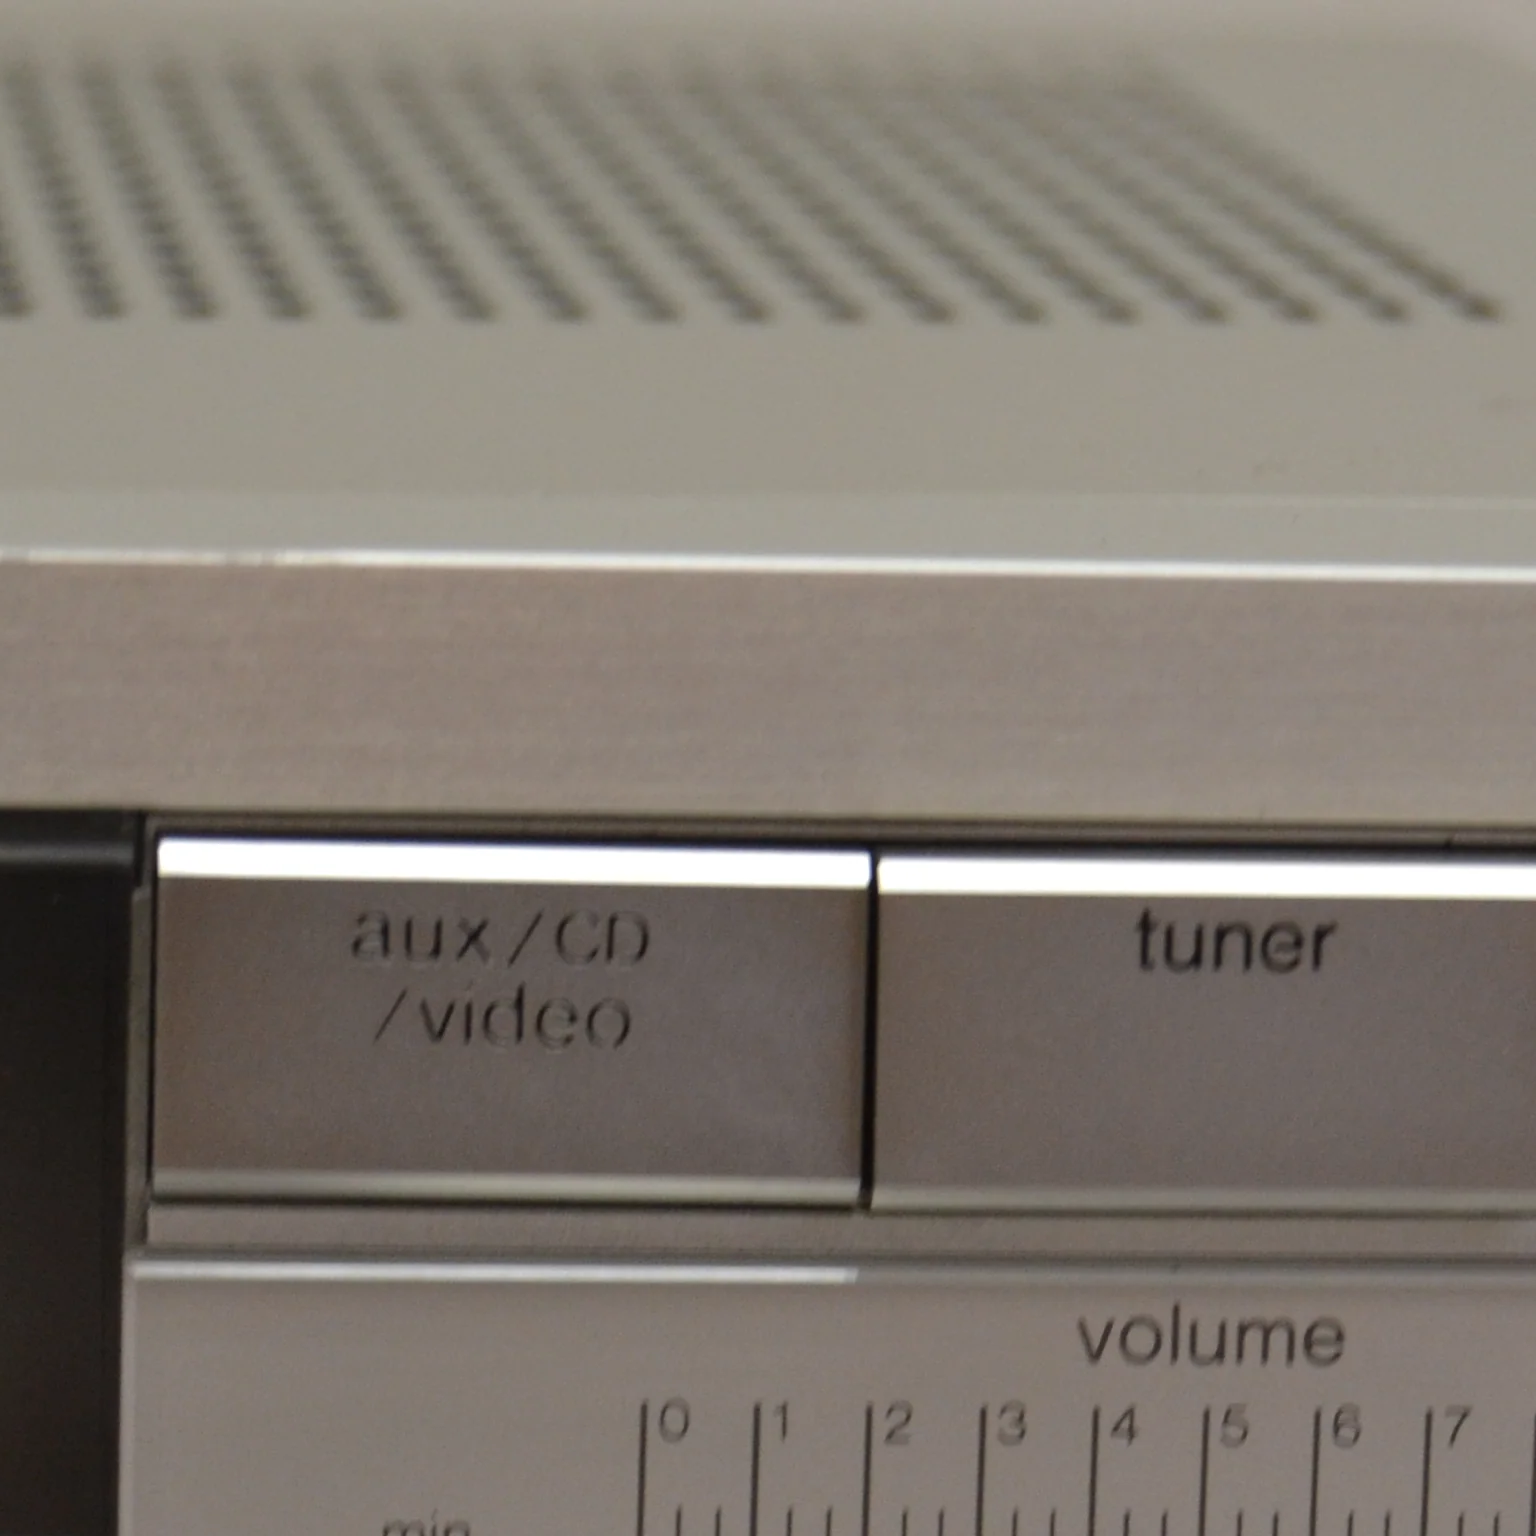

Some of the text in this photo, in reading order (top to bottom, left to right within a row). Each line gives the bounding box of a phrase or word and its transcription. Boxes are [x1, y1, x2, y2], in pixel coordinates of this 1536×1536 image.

[349, 906, 652, 968] aux/CD
[1132, 906, 1340, 975] tuner
[371, 979, 635, 1051] /video
[1077, 1301, 1348, 1369] volume
[658, 1400, 693, 1444] 0
[776, 1401, 791, 1443] 1
[884, 1402, 915, 1447] 2
[998, 1403, 1029, 1446] 3
[1110, 1405, 1140, 1447] 4
[1221, 1405, 1251, 1447] 5
[1332, 1406, 1364, 1448] 6
[1448, 1406, 1474, 1449] 7
